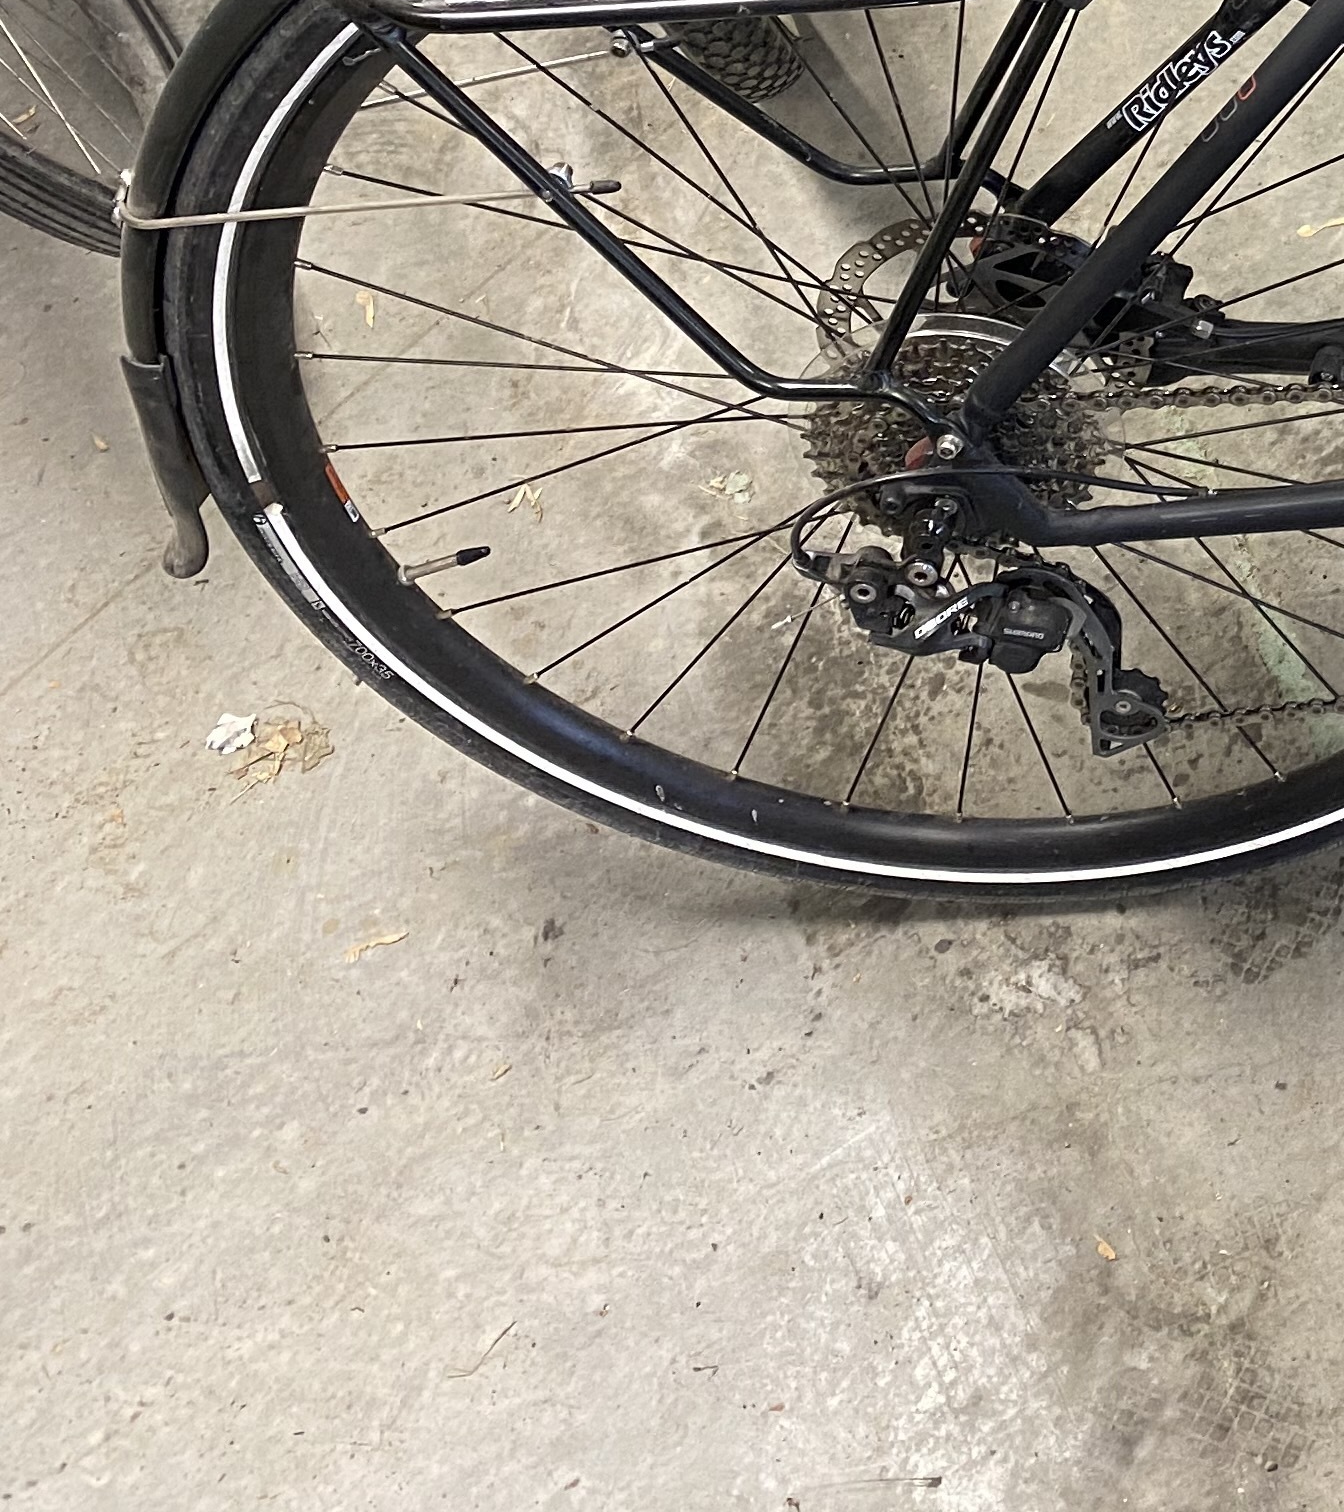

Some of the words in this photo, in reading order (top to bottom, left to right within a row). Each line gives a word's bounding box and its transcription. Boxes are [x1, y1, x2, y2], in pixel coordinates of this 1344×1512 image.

[914, 596, 969, 640] DEORE
[1003, 627, 1045, 640] SHIMANO
[348, 639, 395, 680] 700x35
